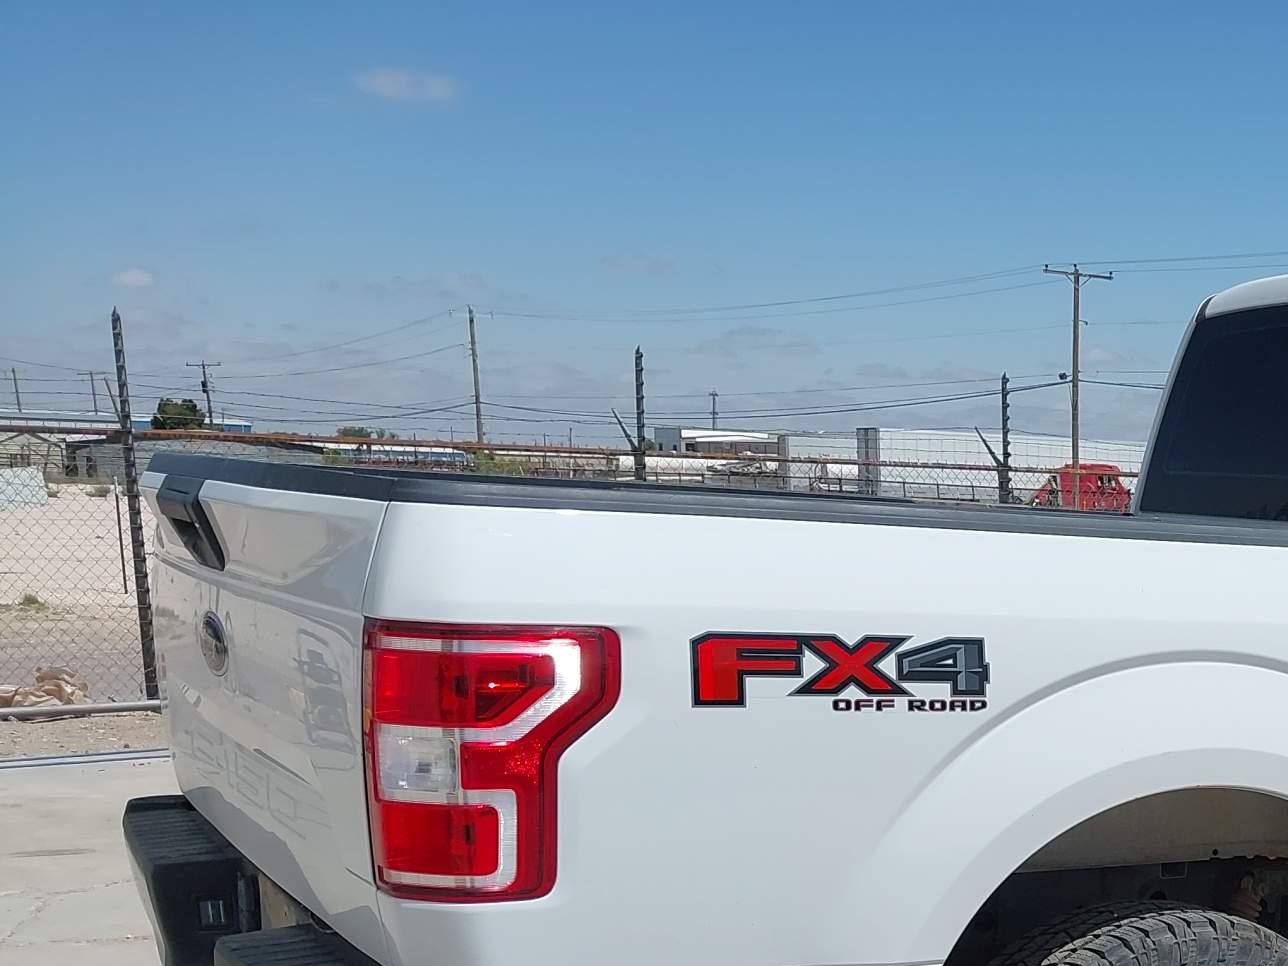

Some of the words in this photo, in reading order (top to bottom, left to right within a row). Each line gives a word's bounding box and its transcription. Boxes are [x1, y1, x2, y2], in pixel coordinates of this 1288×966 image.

[690, 631, 989, 707] FX4
[832, 698, 895, 712] OFF
[908, 698, 987, 712] ROAD
